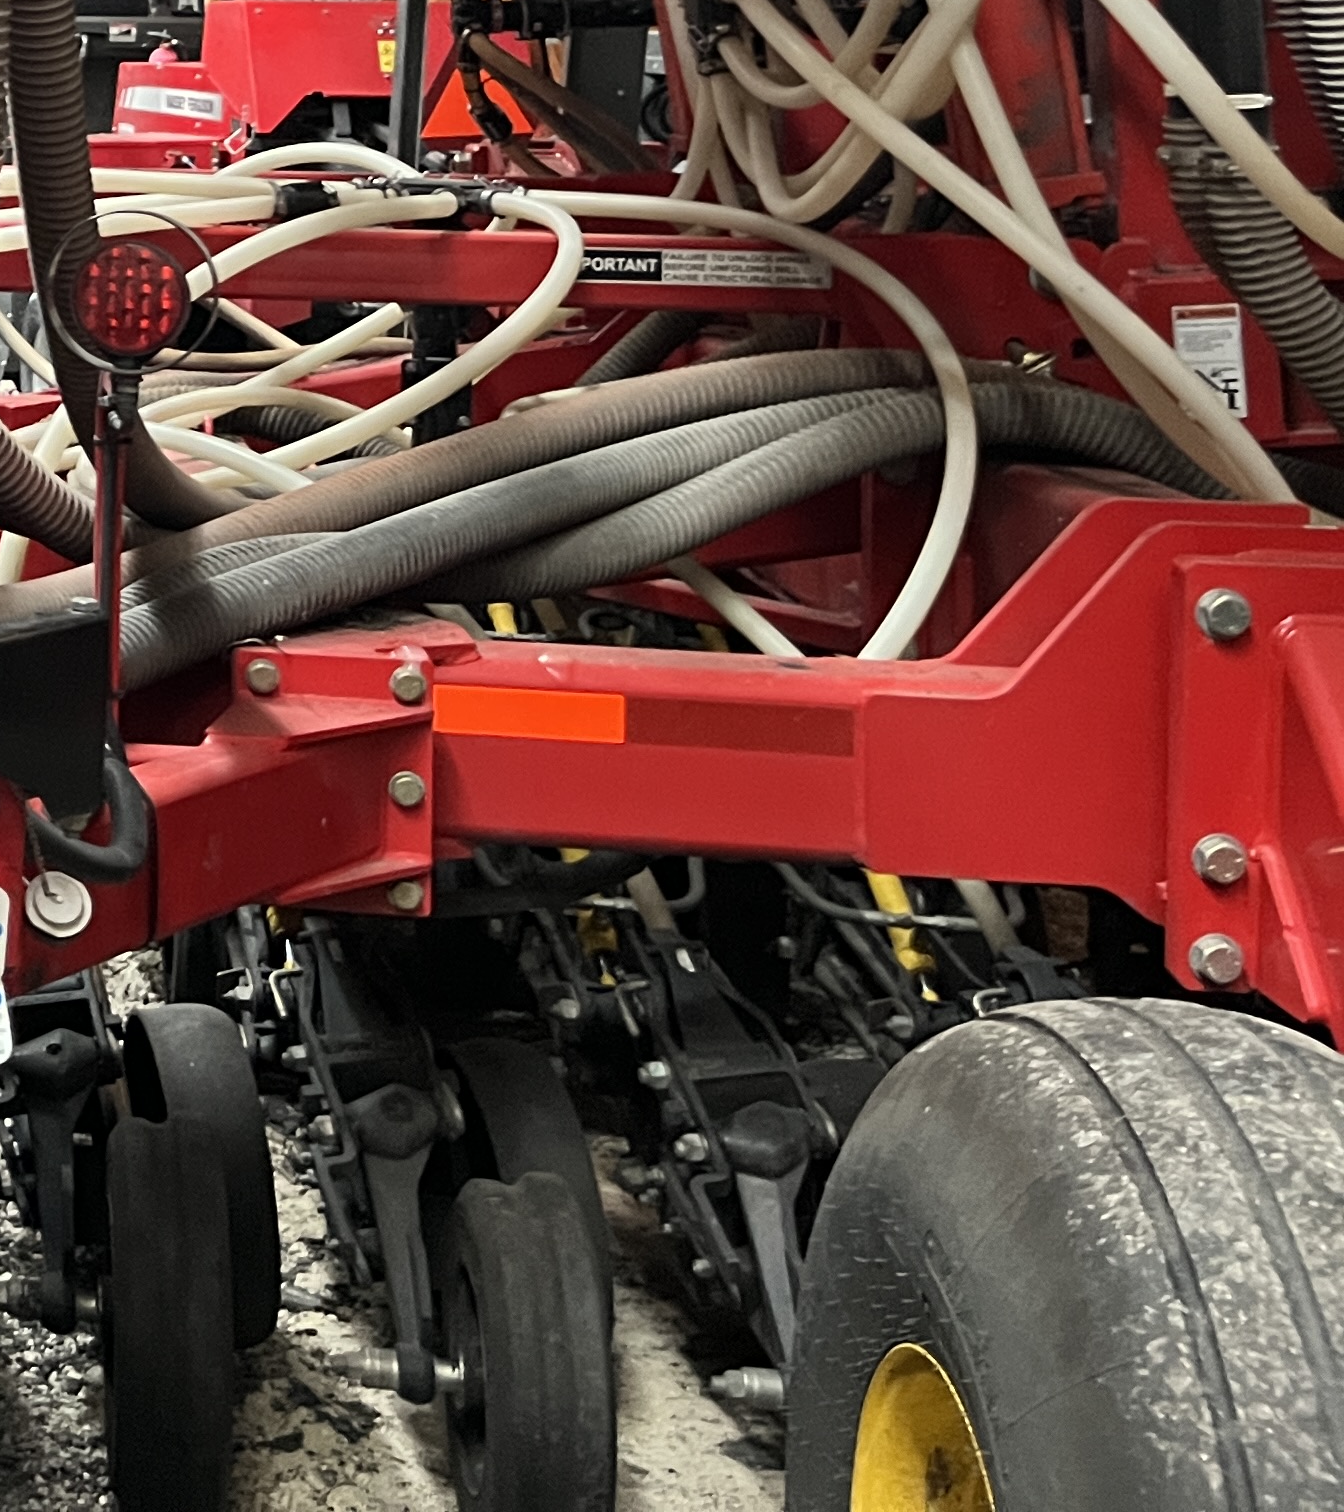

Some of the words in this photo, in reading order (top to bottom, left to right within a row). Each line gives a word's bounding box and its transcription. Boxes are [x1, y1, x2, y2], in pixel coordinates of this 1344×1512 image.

[582, 257, 658, 273] PORTANT
[663, 262, 706, 272] BEFORE
[710, 263, 772, 273] UNFOLDING
[663, 272, 702, 281] CAUSE
[704, 273, 772, 283] STRUCTURAL
